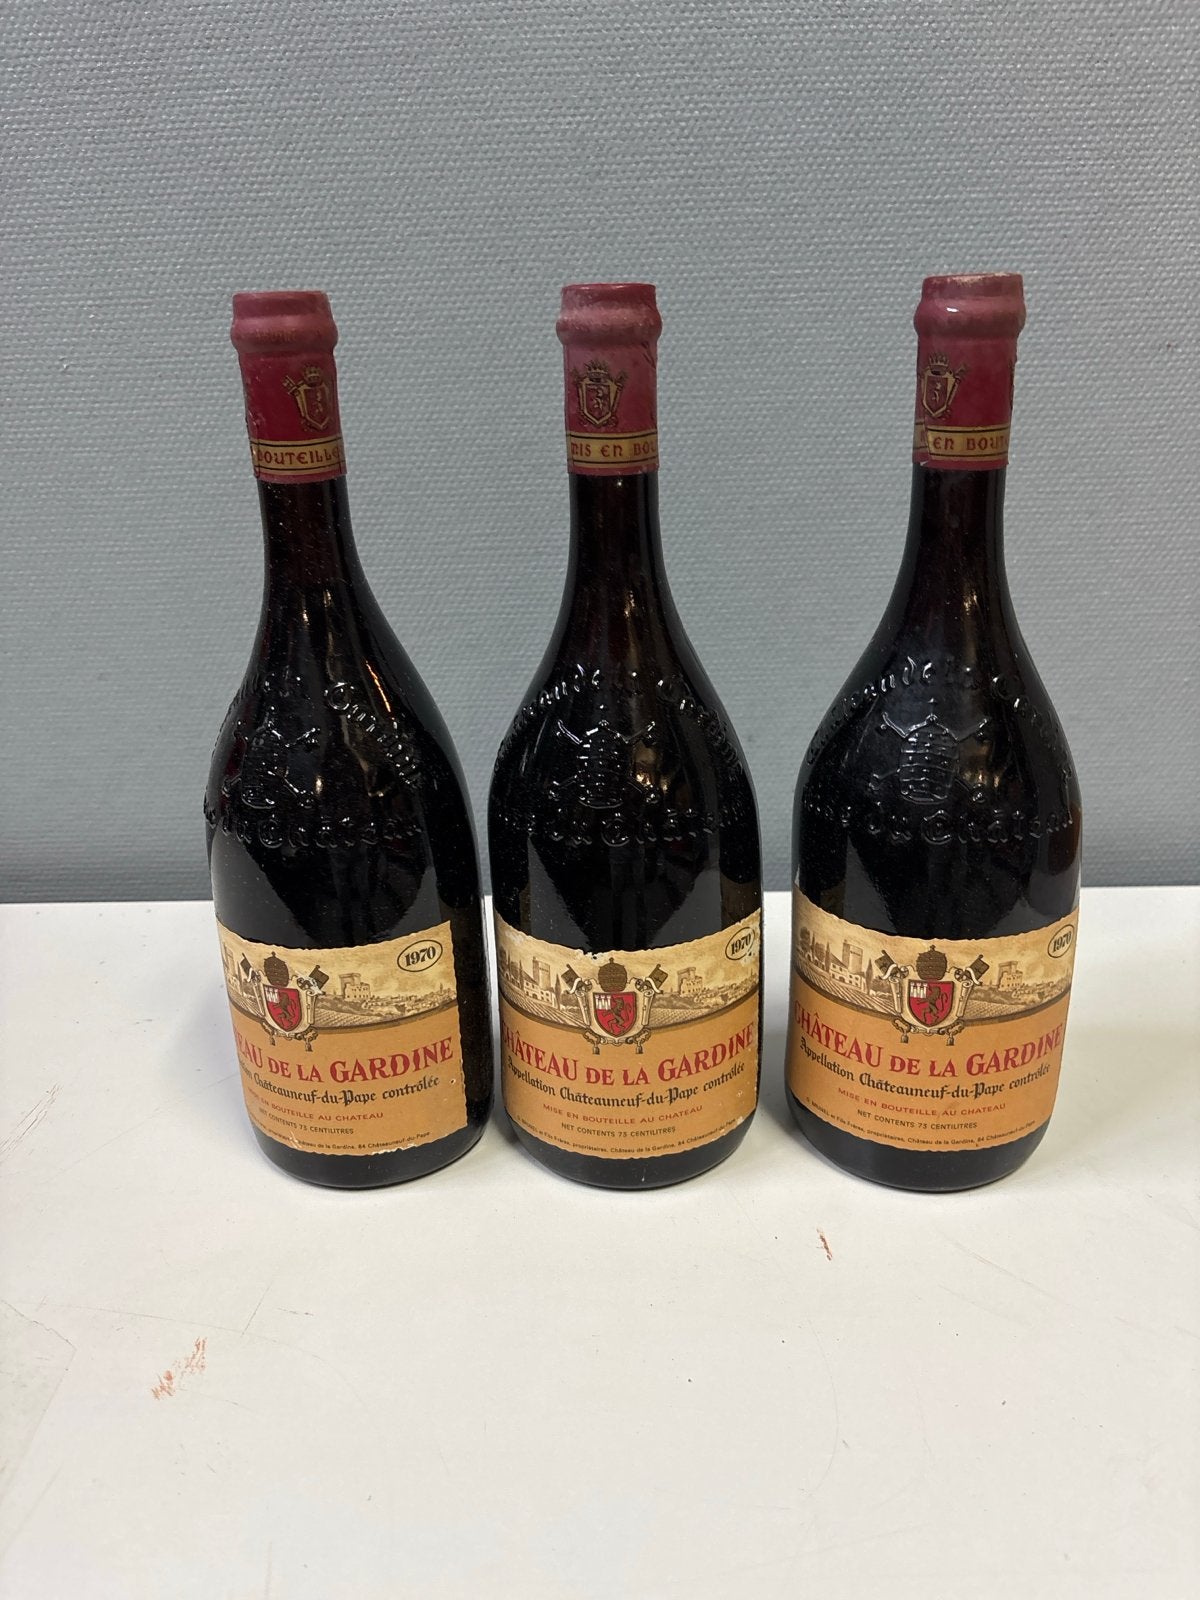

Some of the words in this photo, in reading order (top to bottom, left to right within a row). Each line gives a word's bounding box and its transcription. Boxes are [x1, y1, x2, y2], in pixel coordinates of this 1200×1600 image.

[731, 932, 752, 956] 1970
[1052, 931, 1072, 953] 1970
[405, 945, 436, 967] 1970
[795, 1000, 883, 1068] CHÂTEAU
[889, 1055, 920, 1075] DE
[928, 1058, 958, 1078] LA
[966, 1022, 1063, 1077] GARDINE
[267, 1056, 291, 1078] DE
[296, 1063, 325, 1083] LA
[329, 1036, 454, 1083] GARDINE
[585, 1067, 615, 1086] DE
[623, 1069, 650, 1086] LA
[657, 1021, 755, 1082] GARDINE
[508, 1055, 556, 1097] Appellation
[800, 1036, 855, 1081] Appellation
[859, 1072, 1005, 1100] Châteauneuf-du-Pape
[382, 1075, 440, 1100] contrôlée
[838, 1087, 860, 1102] MISE
[864, 1097, 877, 1107] EN
[881, 1103, 937, 1116] BOUTEILLE
[960, 1103, 1006, 1116] CHATEAU
[318, 1114, 332, 1122] AU
[335, 1112, 384, 1122] CHATEAU
[543, 1103, 564, 1116] MISE
[566, 1111, 579, 1120] EN
[582, 1115, 636, 1125] BOUTEILLE
[640, 1116, 655, 1124] AU
[658, 1105, 703, 1122] CHATEAU
[857, 1109, 872, 1119] NET
[874, 1114, 915, 1128] CONTENTS
[930, 1121, 977, 1130] CENTILITRES
[309, 1126, 354, 1136] CENTILITRES
[561, 1122, 575, 1132] NET
[577, 1126, 615, 1138] CONTENTS
[630, 1125, 676, 1138] CENTILITRES
